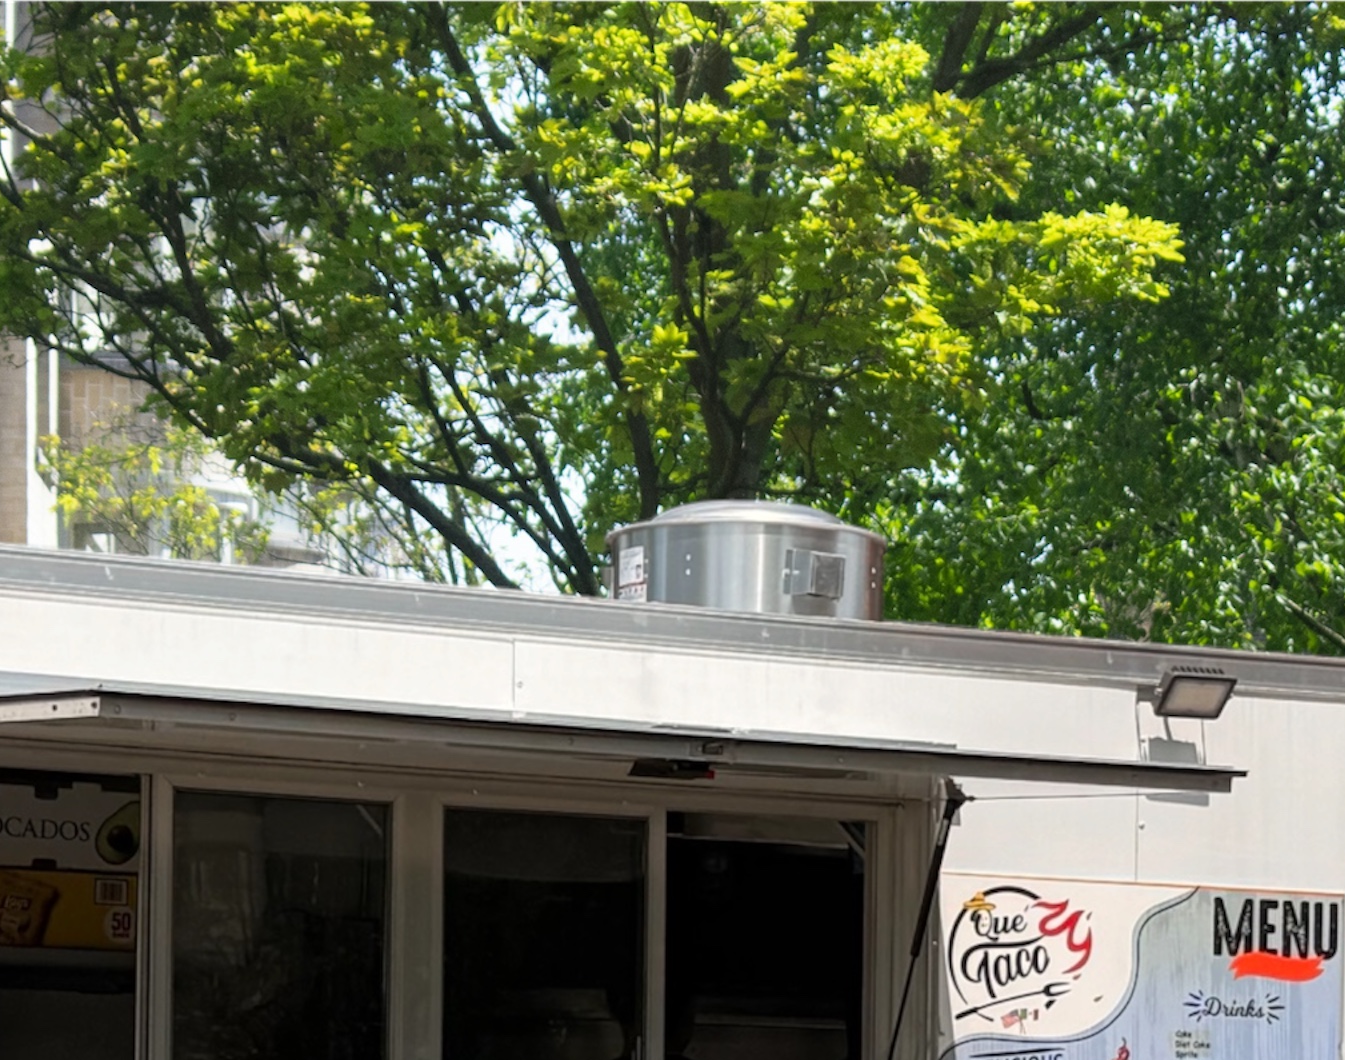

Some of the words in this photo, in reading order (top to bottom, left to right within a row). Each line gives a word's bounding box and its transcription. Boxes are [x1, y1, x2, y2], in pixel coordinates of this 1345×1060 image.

[112, 913, 130, 930] 50
[1214, 897, 1338, 960] MENU
[961, 935, 1050, 998] Taco
[1202, 996, 1265, 1018] Drinks
[1175, 1030, 1192, 1038] Coke
[1175, 1051, 1198, 1059] Sprite
